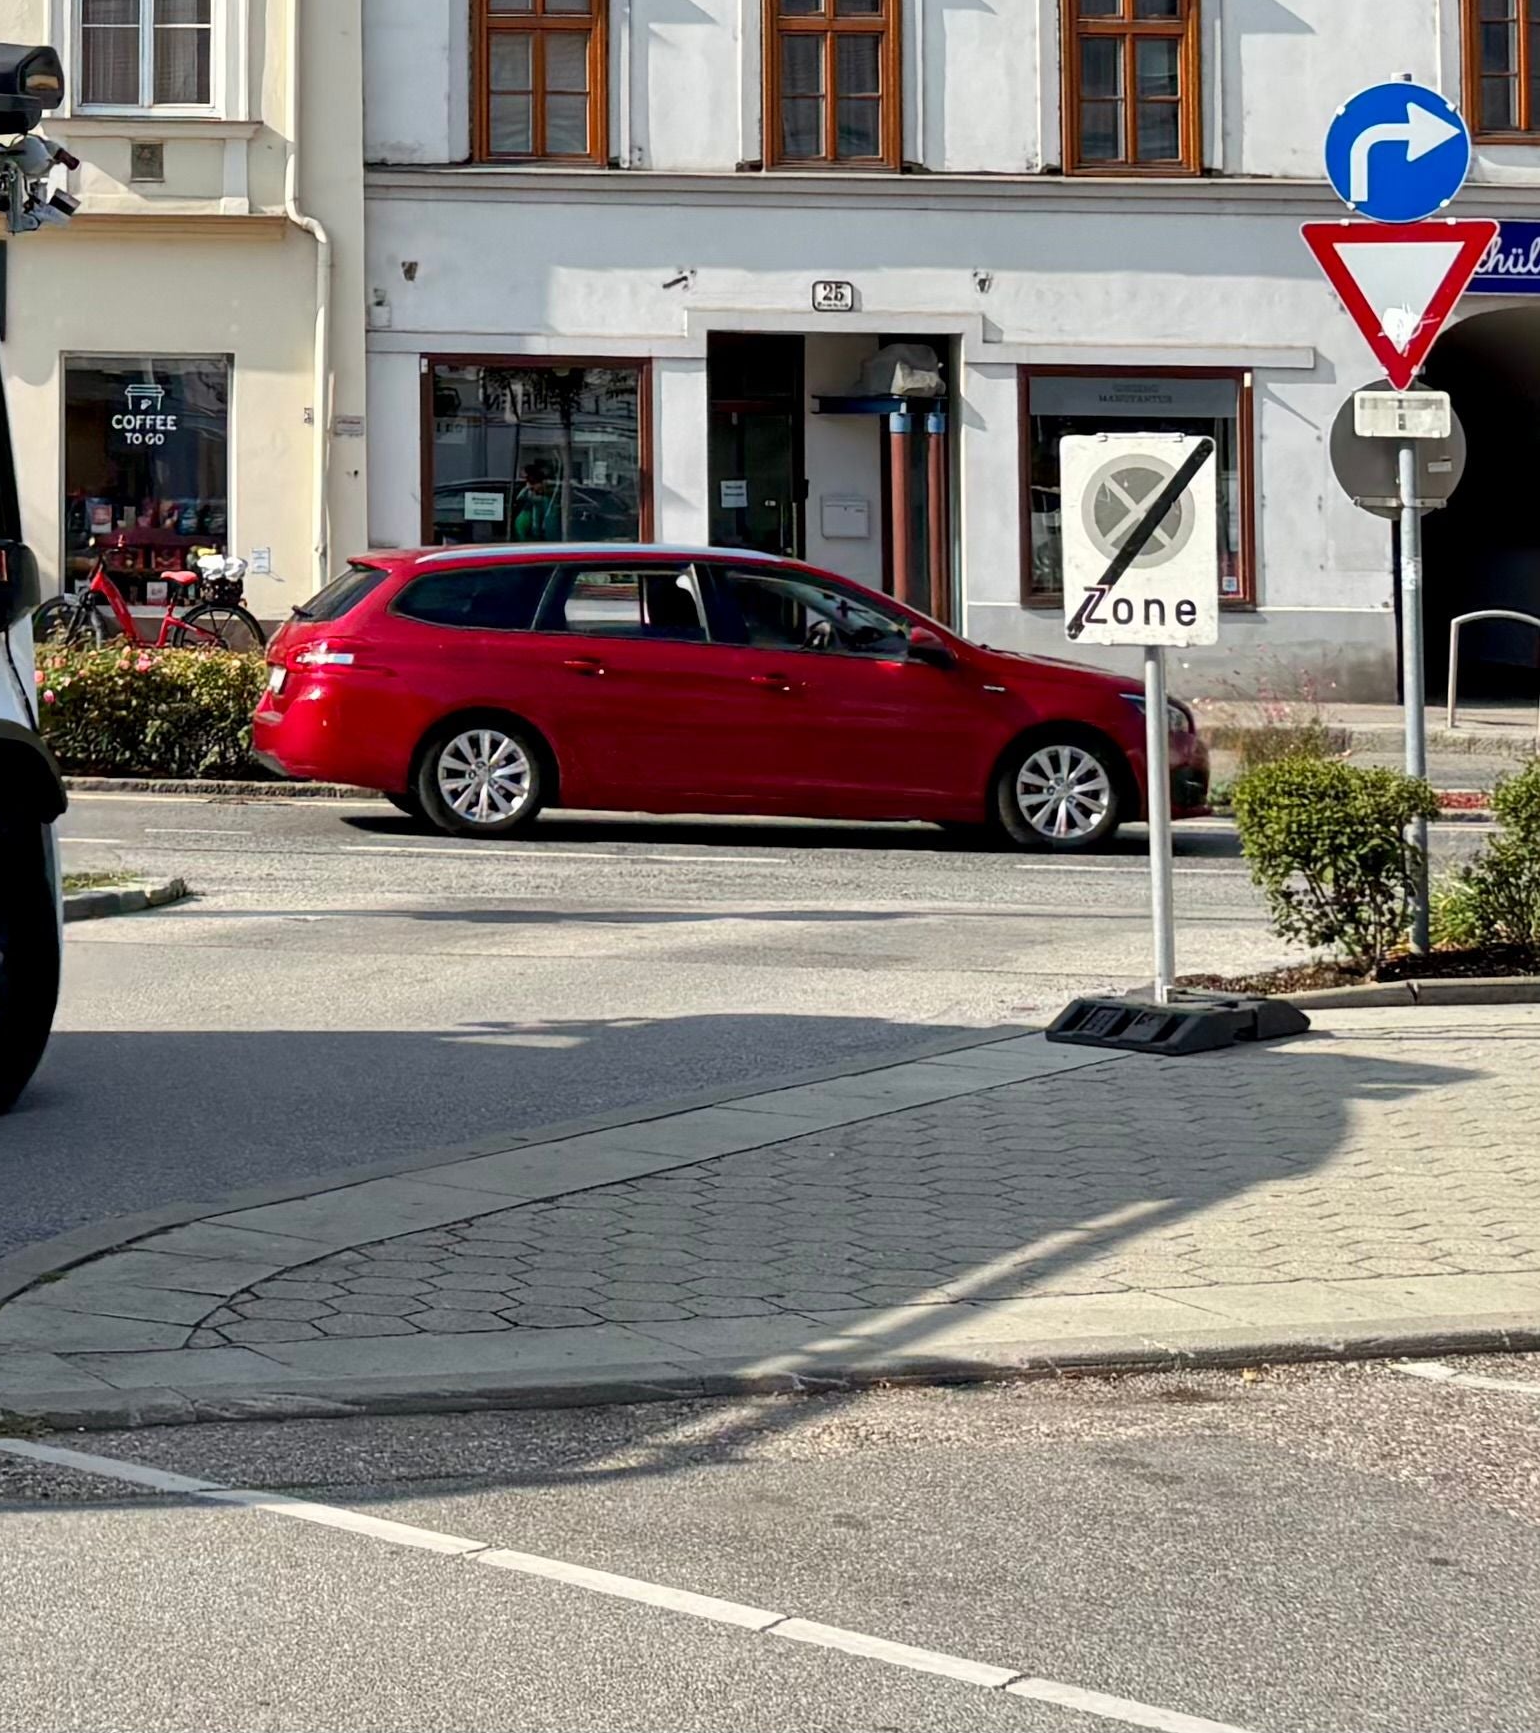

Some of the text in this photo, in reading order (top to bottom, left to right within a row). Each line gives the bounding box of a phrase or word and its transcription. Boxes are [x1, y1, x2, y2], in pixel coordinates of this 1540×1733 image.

[111, 414, 177, 430] COFFEE
[124, 433, 165, 445] TO GO
[1083, 586, 1197, 627] Zone
